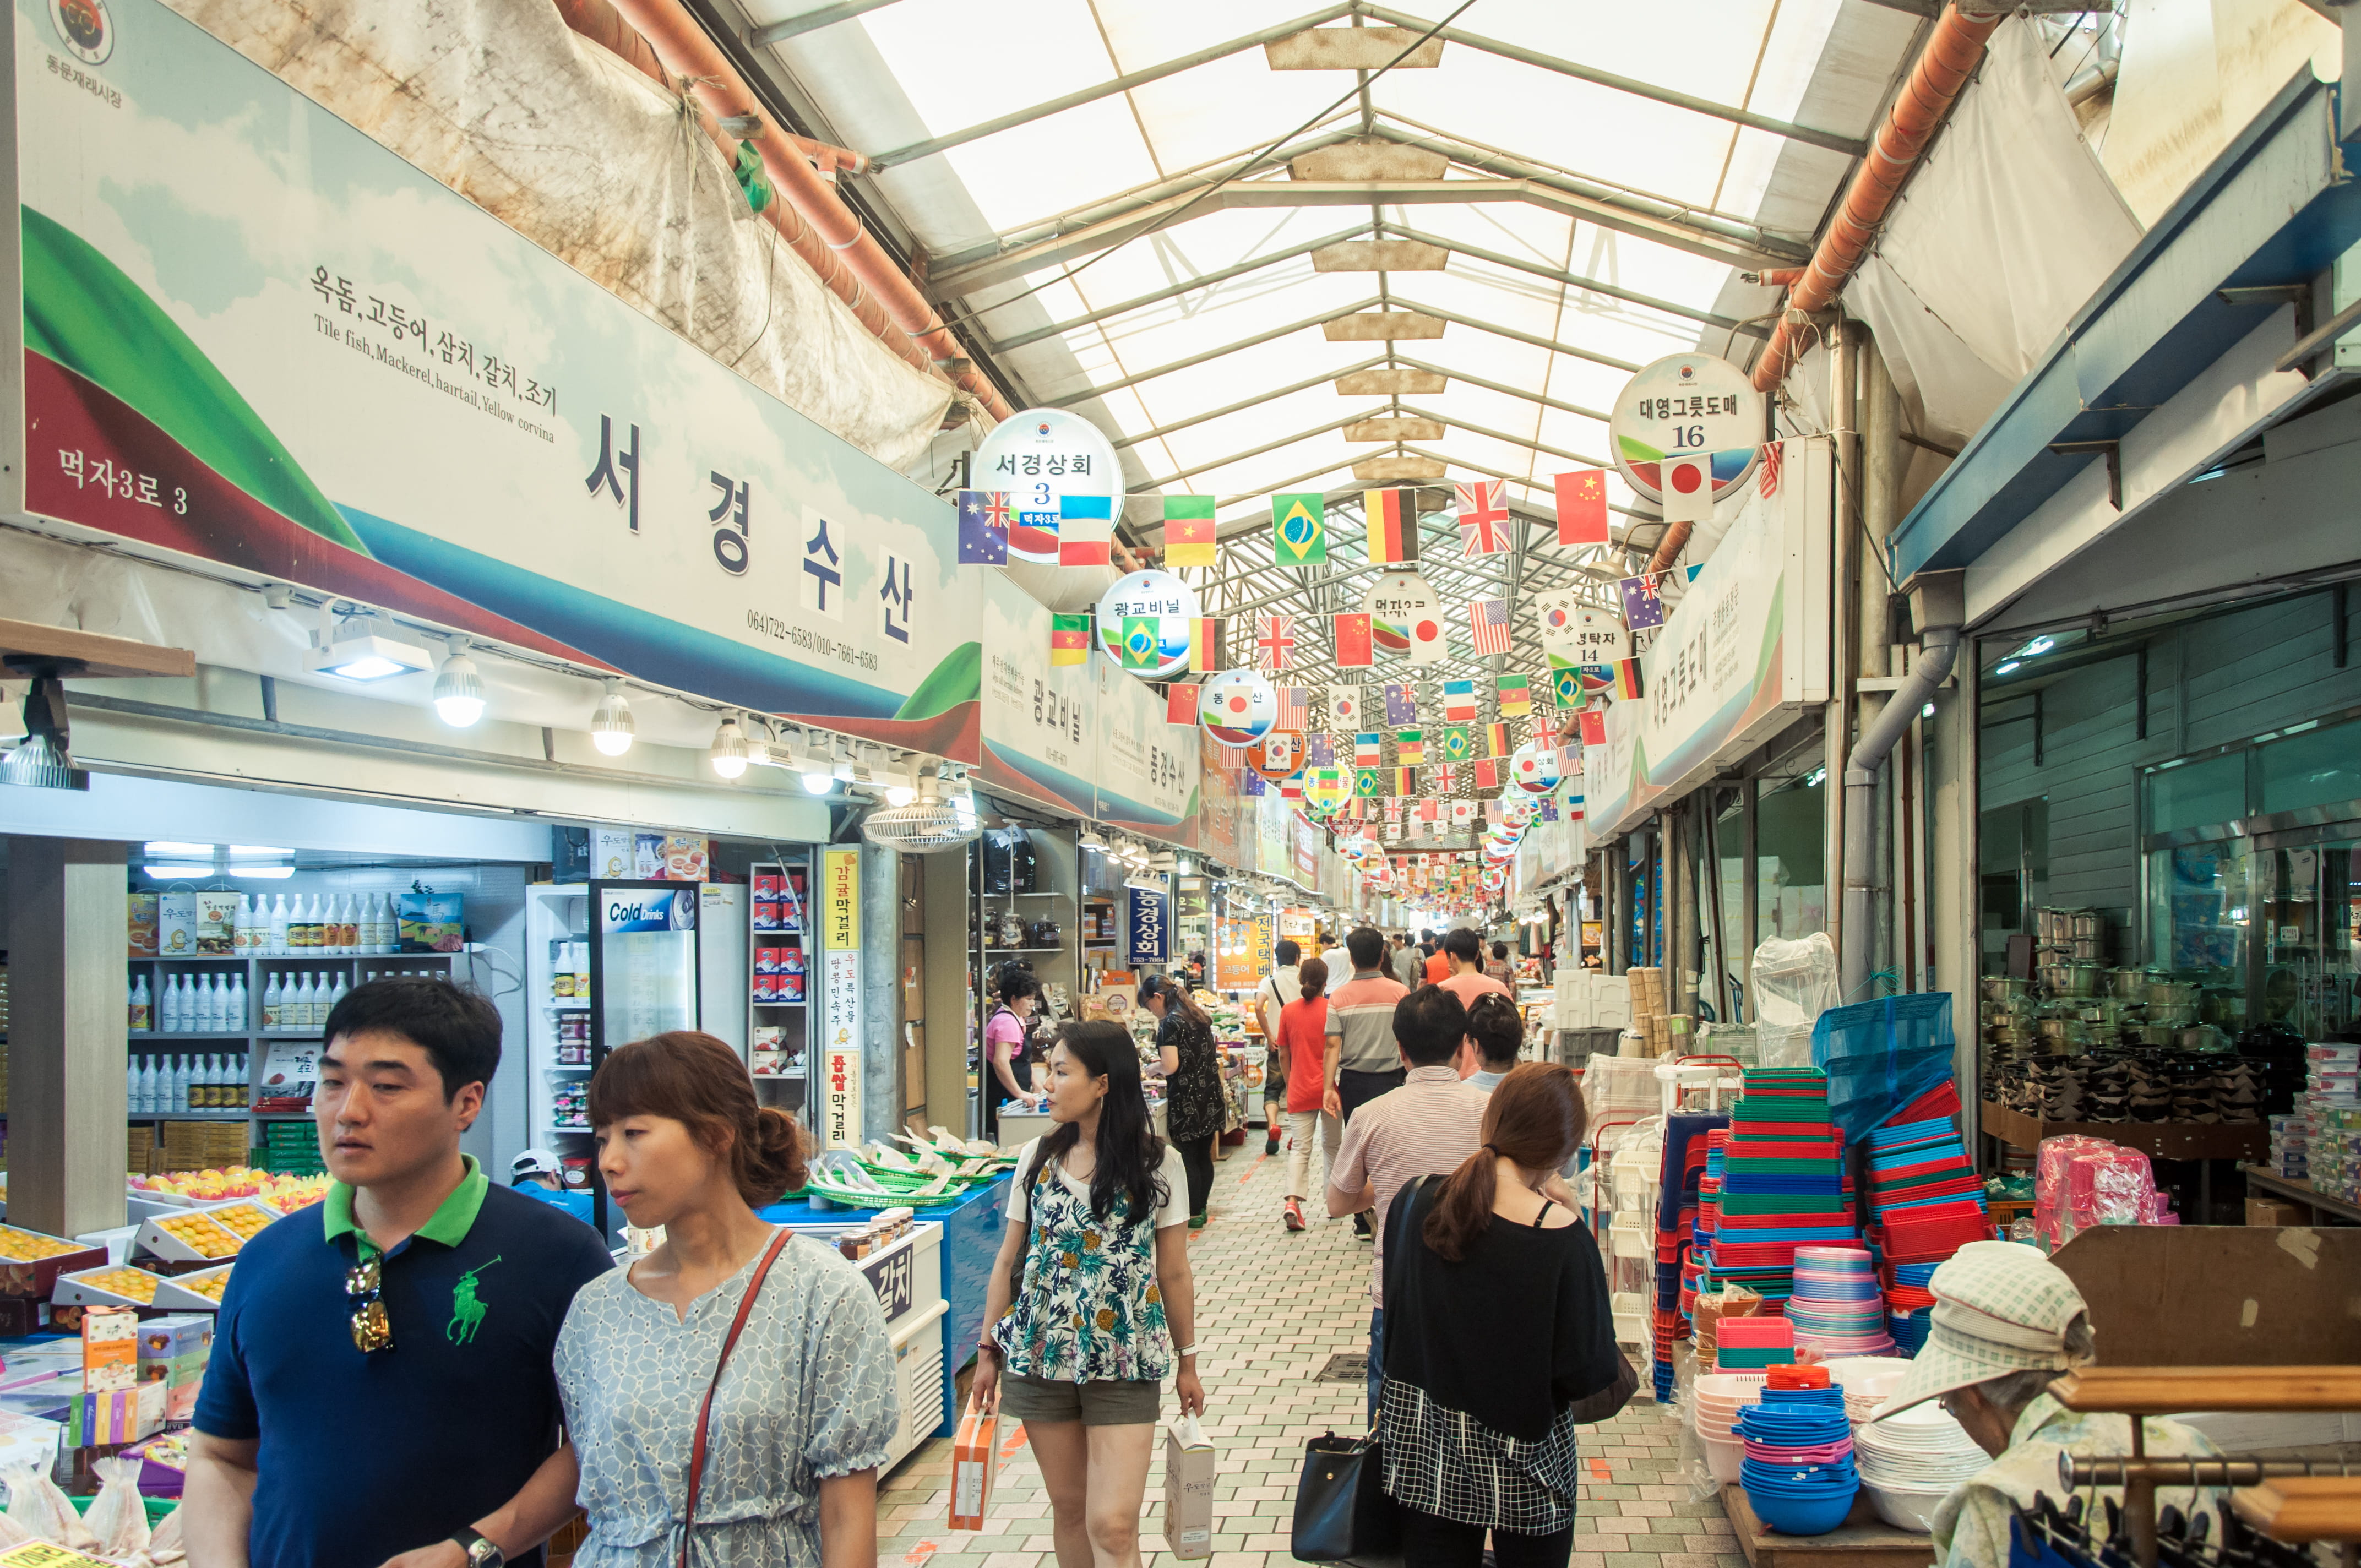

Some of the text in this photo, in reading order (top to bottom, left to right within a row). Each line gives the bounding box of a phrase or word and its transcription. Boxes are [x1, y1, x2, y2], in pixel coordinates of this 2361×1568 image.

[47, 55, 122, 109] 동문재래시장
[311, 265, 556, 417] 옥돔,고등어,삼치,갈치,조기
[314, 314, 340, 341] Tile
[518, 418, 554, 443] corvina
[1640, 394, 1737, 419] 대영그릇도매
[1672, 426, 1705, 448] 16
[58, 449, 188, 515] 먹자3로 3
[996, 454, 1091, 476] 서경상회
[1034, 483, 1050, 504] 3
[1114, 598, 1180, 616] 광교비닐
[1580, 649, 1598, 662] 14
[1654, 618, 1707, 730] 대영그릇도매
[1034, 678, 1080, 743] 광교비닐
[1151, 745, 1185, 795] 동경수산
[610, 902, 664, 921] Cold Drinks
[1136, 890, 1163, 956] 동경상회
[1222, 964, 1250, 975] 고등어
[1256, 915, 1271, 977] 전국택배
[878, 1249, 911, 1317] 갈치
